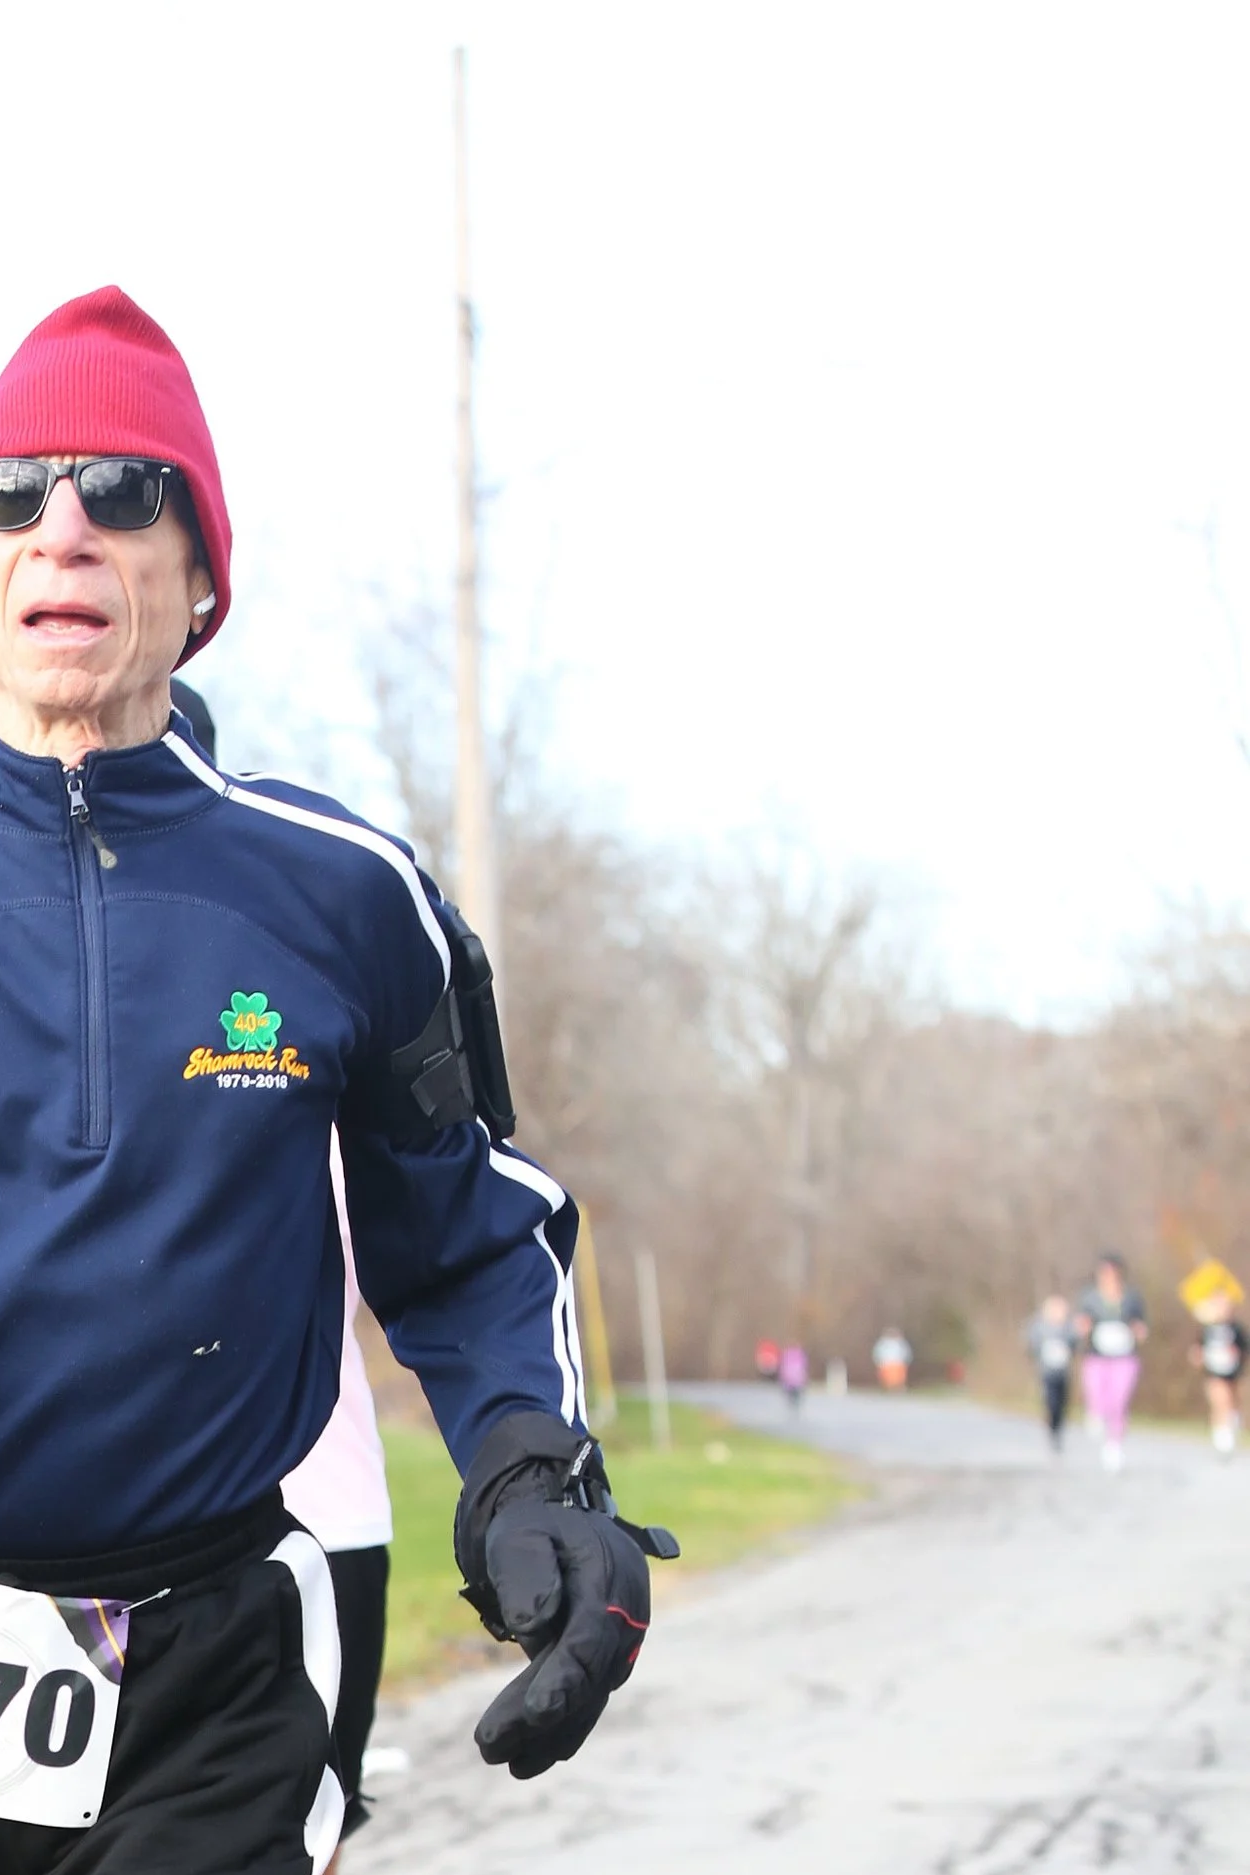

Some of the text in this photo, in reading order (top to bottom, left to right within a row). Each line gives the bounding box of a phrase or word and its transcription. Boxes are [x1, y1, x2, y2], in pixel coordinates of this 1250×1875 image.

[183, 1046, 311, 1081] Shamrock Run
[216, 1073, 288, 1089] 1979-2018
